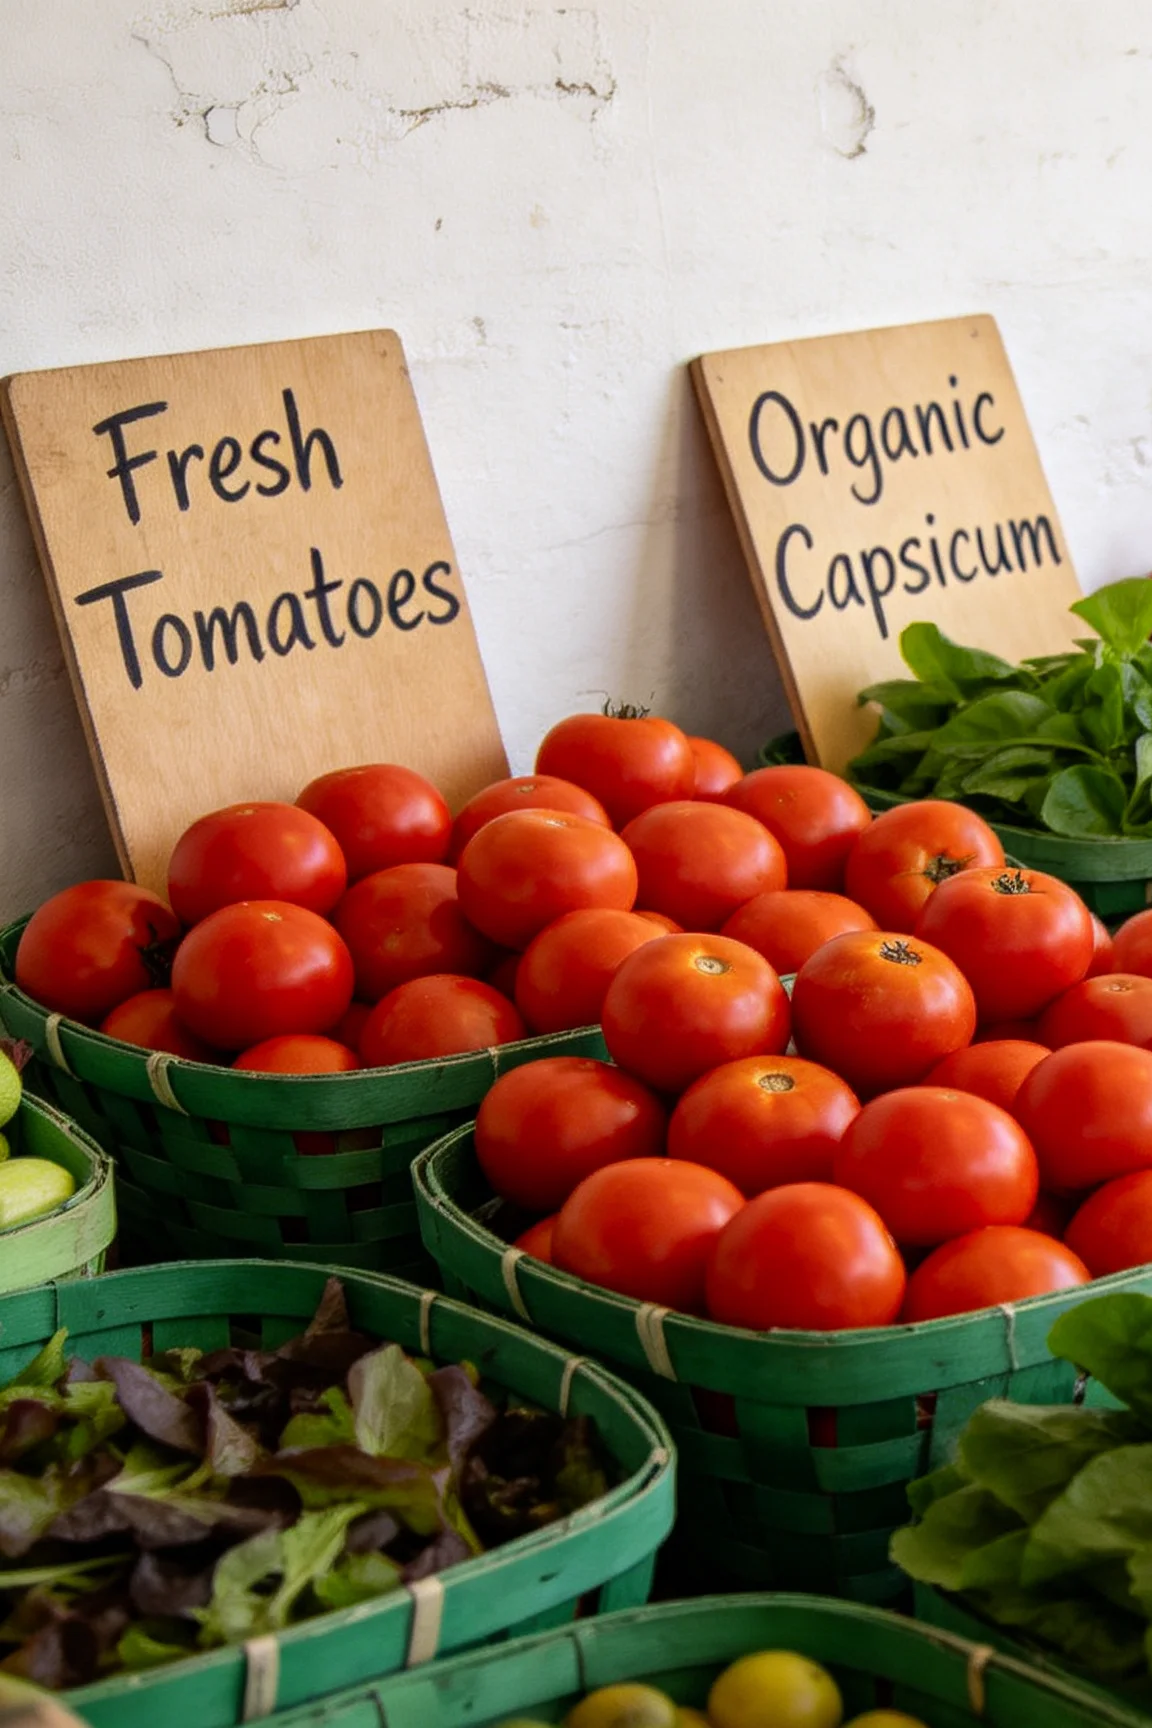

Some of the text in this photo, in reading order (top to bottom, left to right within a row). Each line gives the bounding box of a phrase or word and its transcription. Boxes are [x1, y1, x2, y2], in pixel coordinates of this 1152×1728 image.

[93, 389, 343, 525] Fresh
[748, 375, 1005, 505] Organic
[75, 548, 461, 689] Tomatoes
[775, 513, 1062, 638] Capsicum
